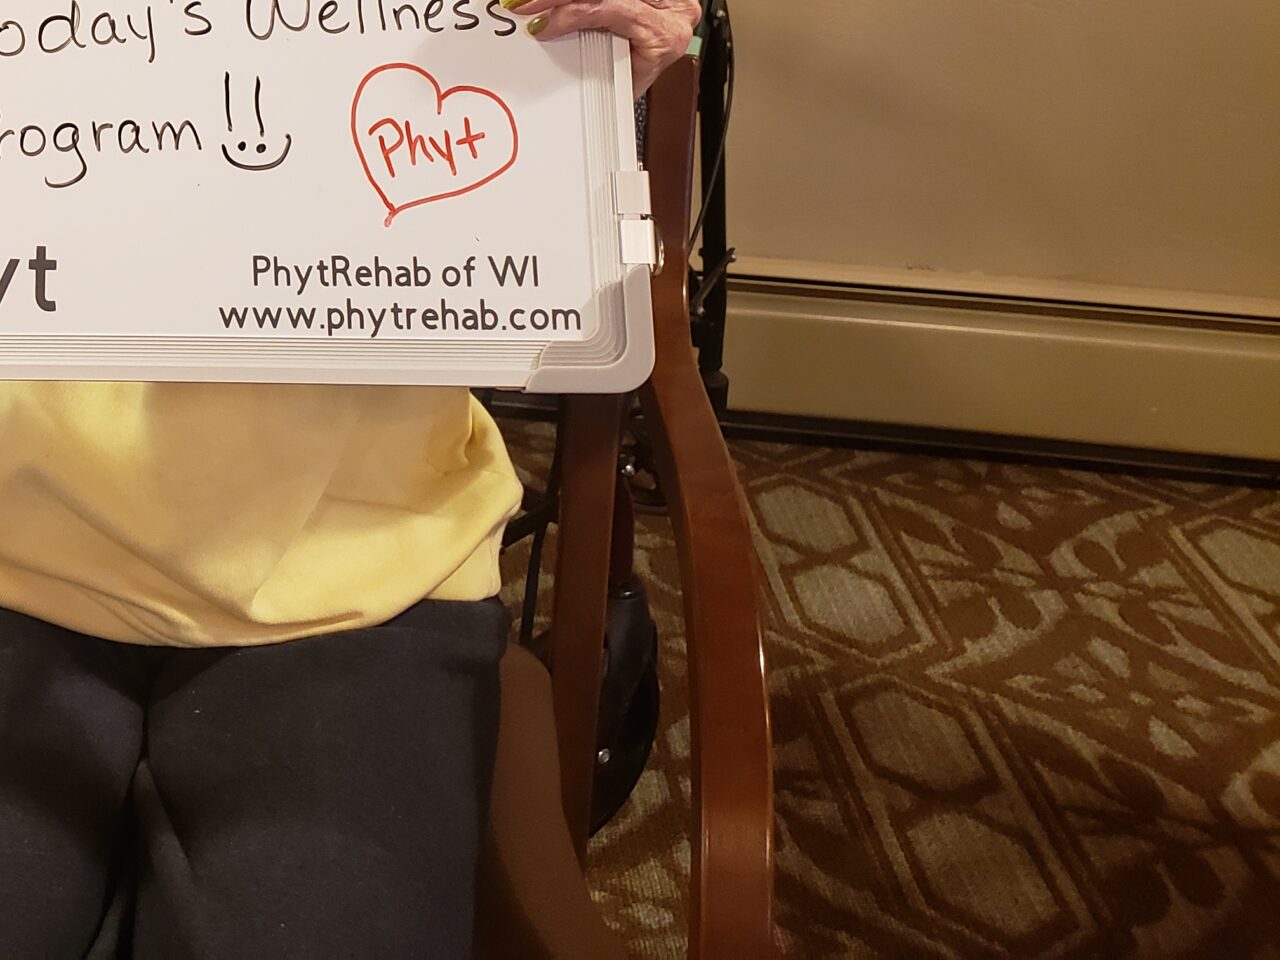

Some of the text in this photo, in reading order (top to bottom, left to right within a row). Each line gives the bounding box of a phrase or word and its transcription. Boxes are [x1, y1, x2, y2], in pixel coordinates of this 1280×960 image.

[368, 116, 486, 177] Phyt
[252, 255, 540, 295] PhytRehab of WI
[219, 300, 582, 338] www.phytrehab.com
